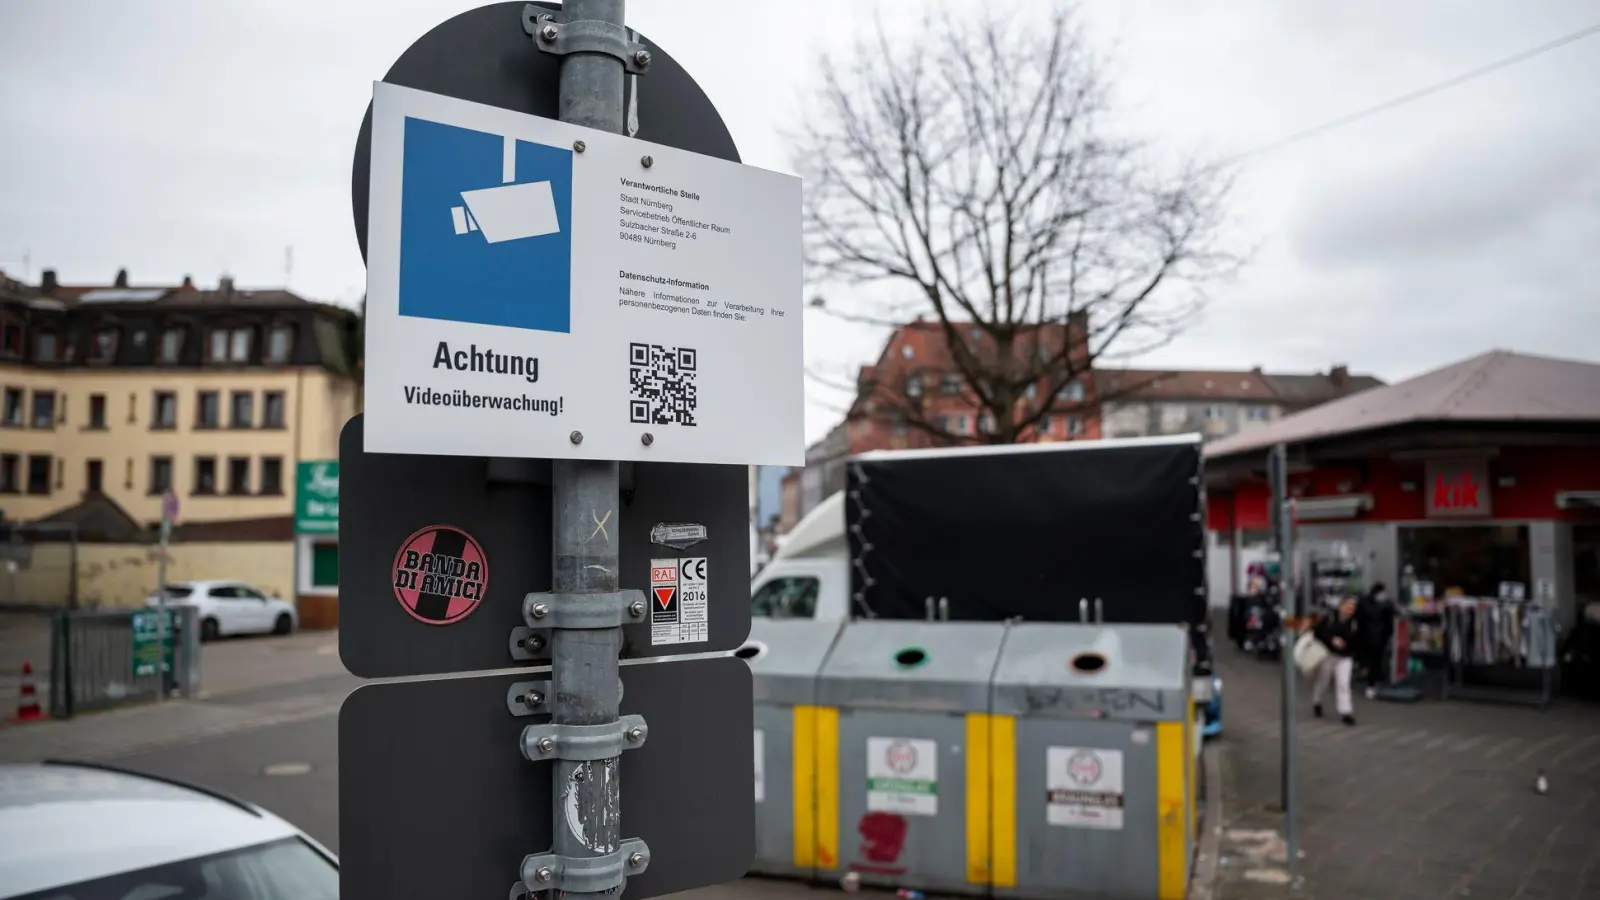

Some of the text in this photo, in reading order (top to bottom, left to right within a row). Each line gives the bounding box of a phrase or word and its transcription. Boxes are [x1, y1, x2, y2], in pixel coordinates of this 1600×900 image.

[620, 178, 700, 201] Verantwortliche Stelle
[620, 193, 673, 212] Stadt Nürnberg
[620, 206, 730, 234] Servicebetrieb Öffentlicher Raum
[620, 219, 697, 240] Sulzbacher Straße 2-6
[619, 232, 676, 250] 90489 Nürnberg
[619, 270, 709, 291] Datenschutz-Information
[619, 287, 645, 298] Nähere
[653, 291, 700, 305] Informationen
[706, 300, 717, 308] zur
[724, 301, 764, 315] Verarbeitung
[619, 298, 747, 321] personenbezogenen Daten finden Sie:
[433, 341, 539, 383] Achtung
[404, 386, 564, 416] Videoüberwachung!
[404, 549, 481, 581] BANDA
[654, 570, 675, 580] RAL
[394, 568, 484, 601] DI AMICI
[683, 591, 706, 601] 2016
